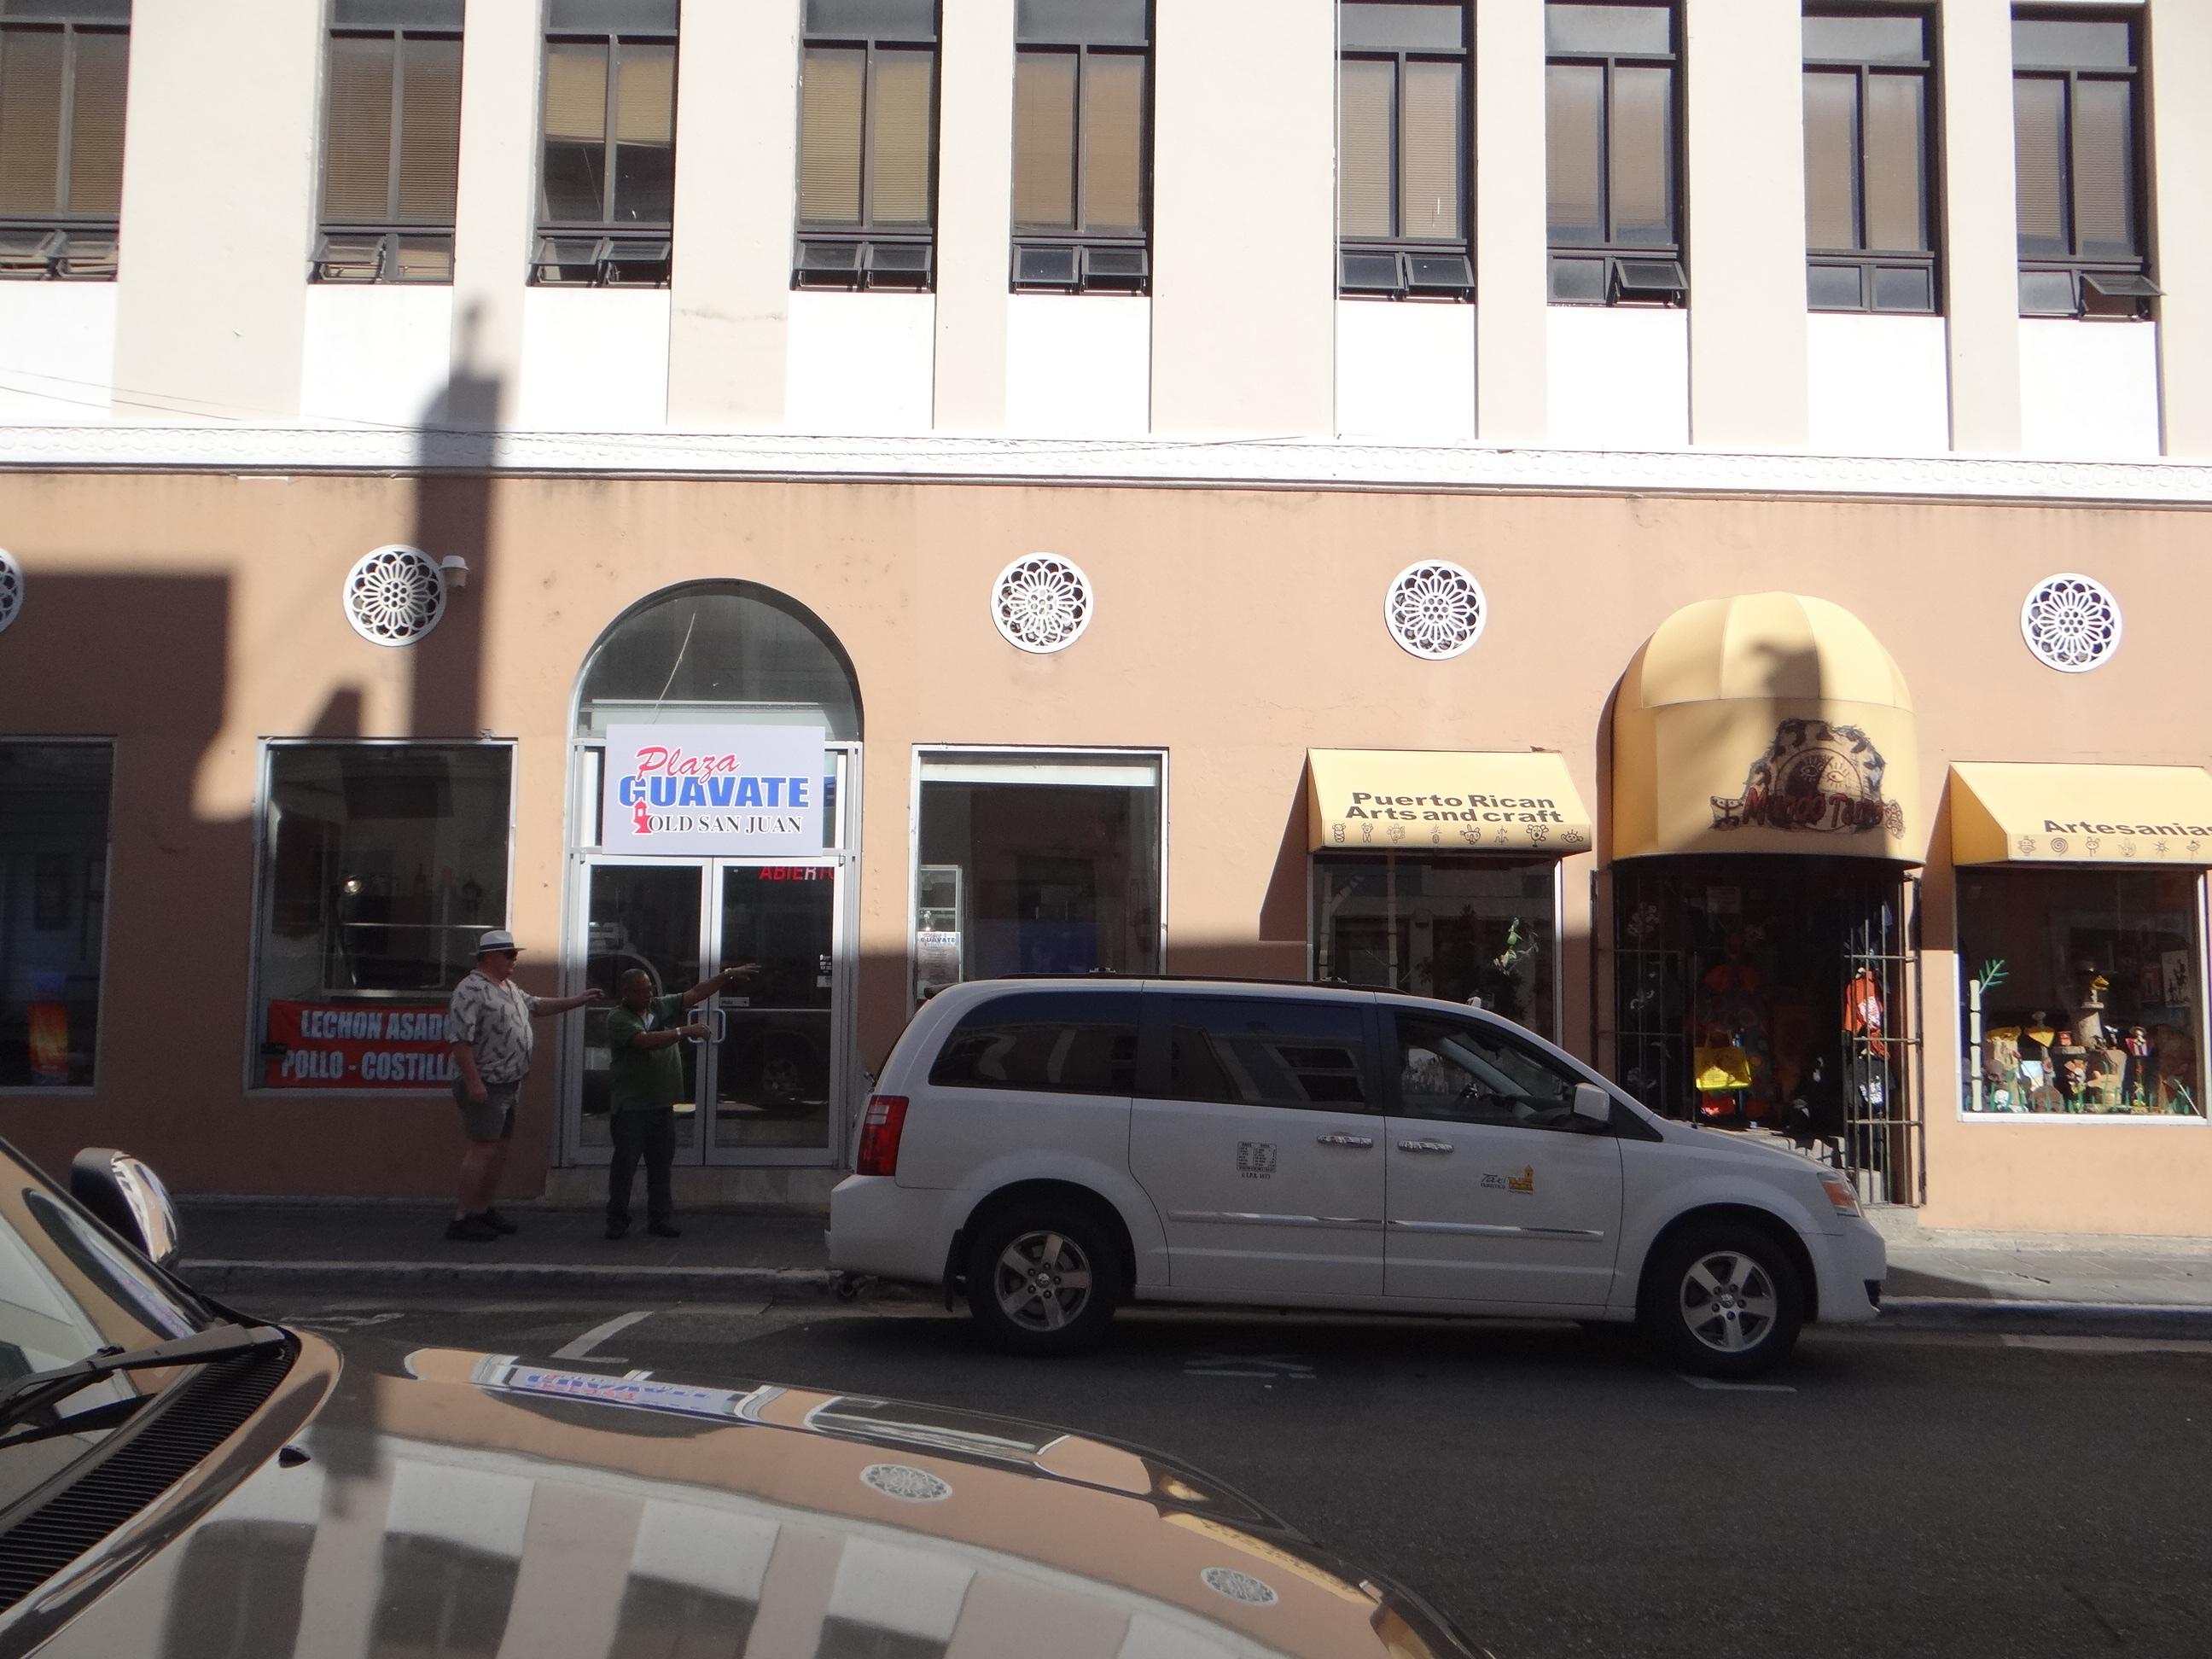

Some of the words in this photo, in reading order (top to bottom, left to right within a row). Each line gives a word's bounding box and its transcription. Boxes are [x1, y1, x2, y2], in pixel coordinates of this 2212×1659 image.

[636, 747, 739, 785] Plaza
[620, 776, 809, 807] GUAVATE
[1352, 792, 1463, 807] Puerto
[1468, 795, 1555, 808] Rican
[649, 816, 693, 832] OLD
[698, 816, 740, 832] SAN
[745, 817, 801, 834] JUAN
[1346, 806, 1419, 821] Arts
[1423, 808, 1477, 822] and
[1482, 809, 1564, 823] craft
[300, 1010, 382, 1039] LECHON
[282, 1050, 344, 1080] POLLO
